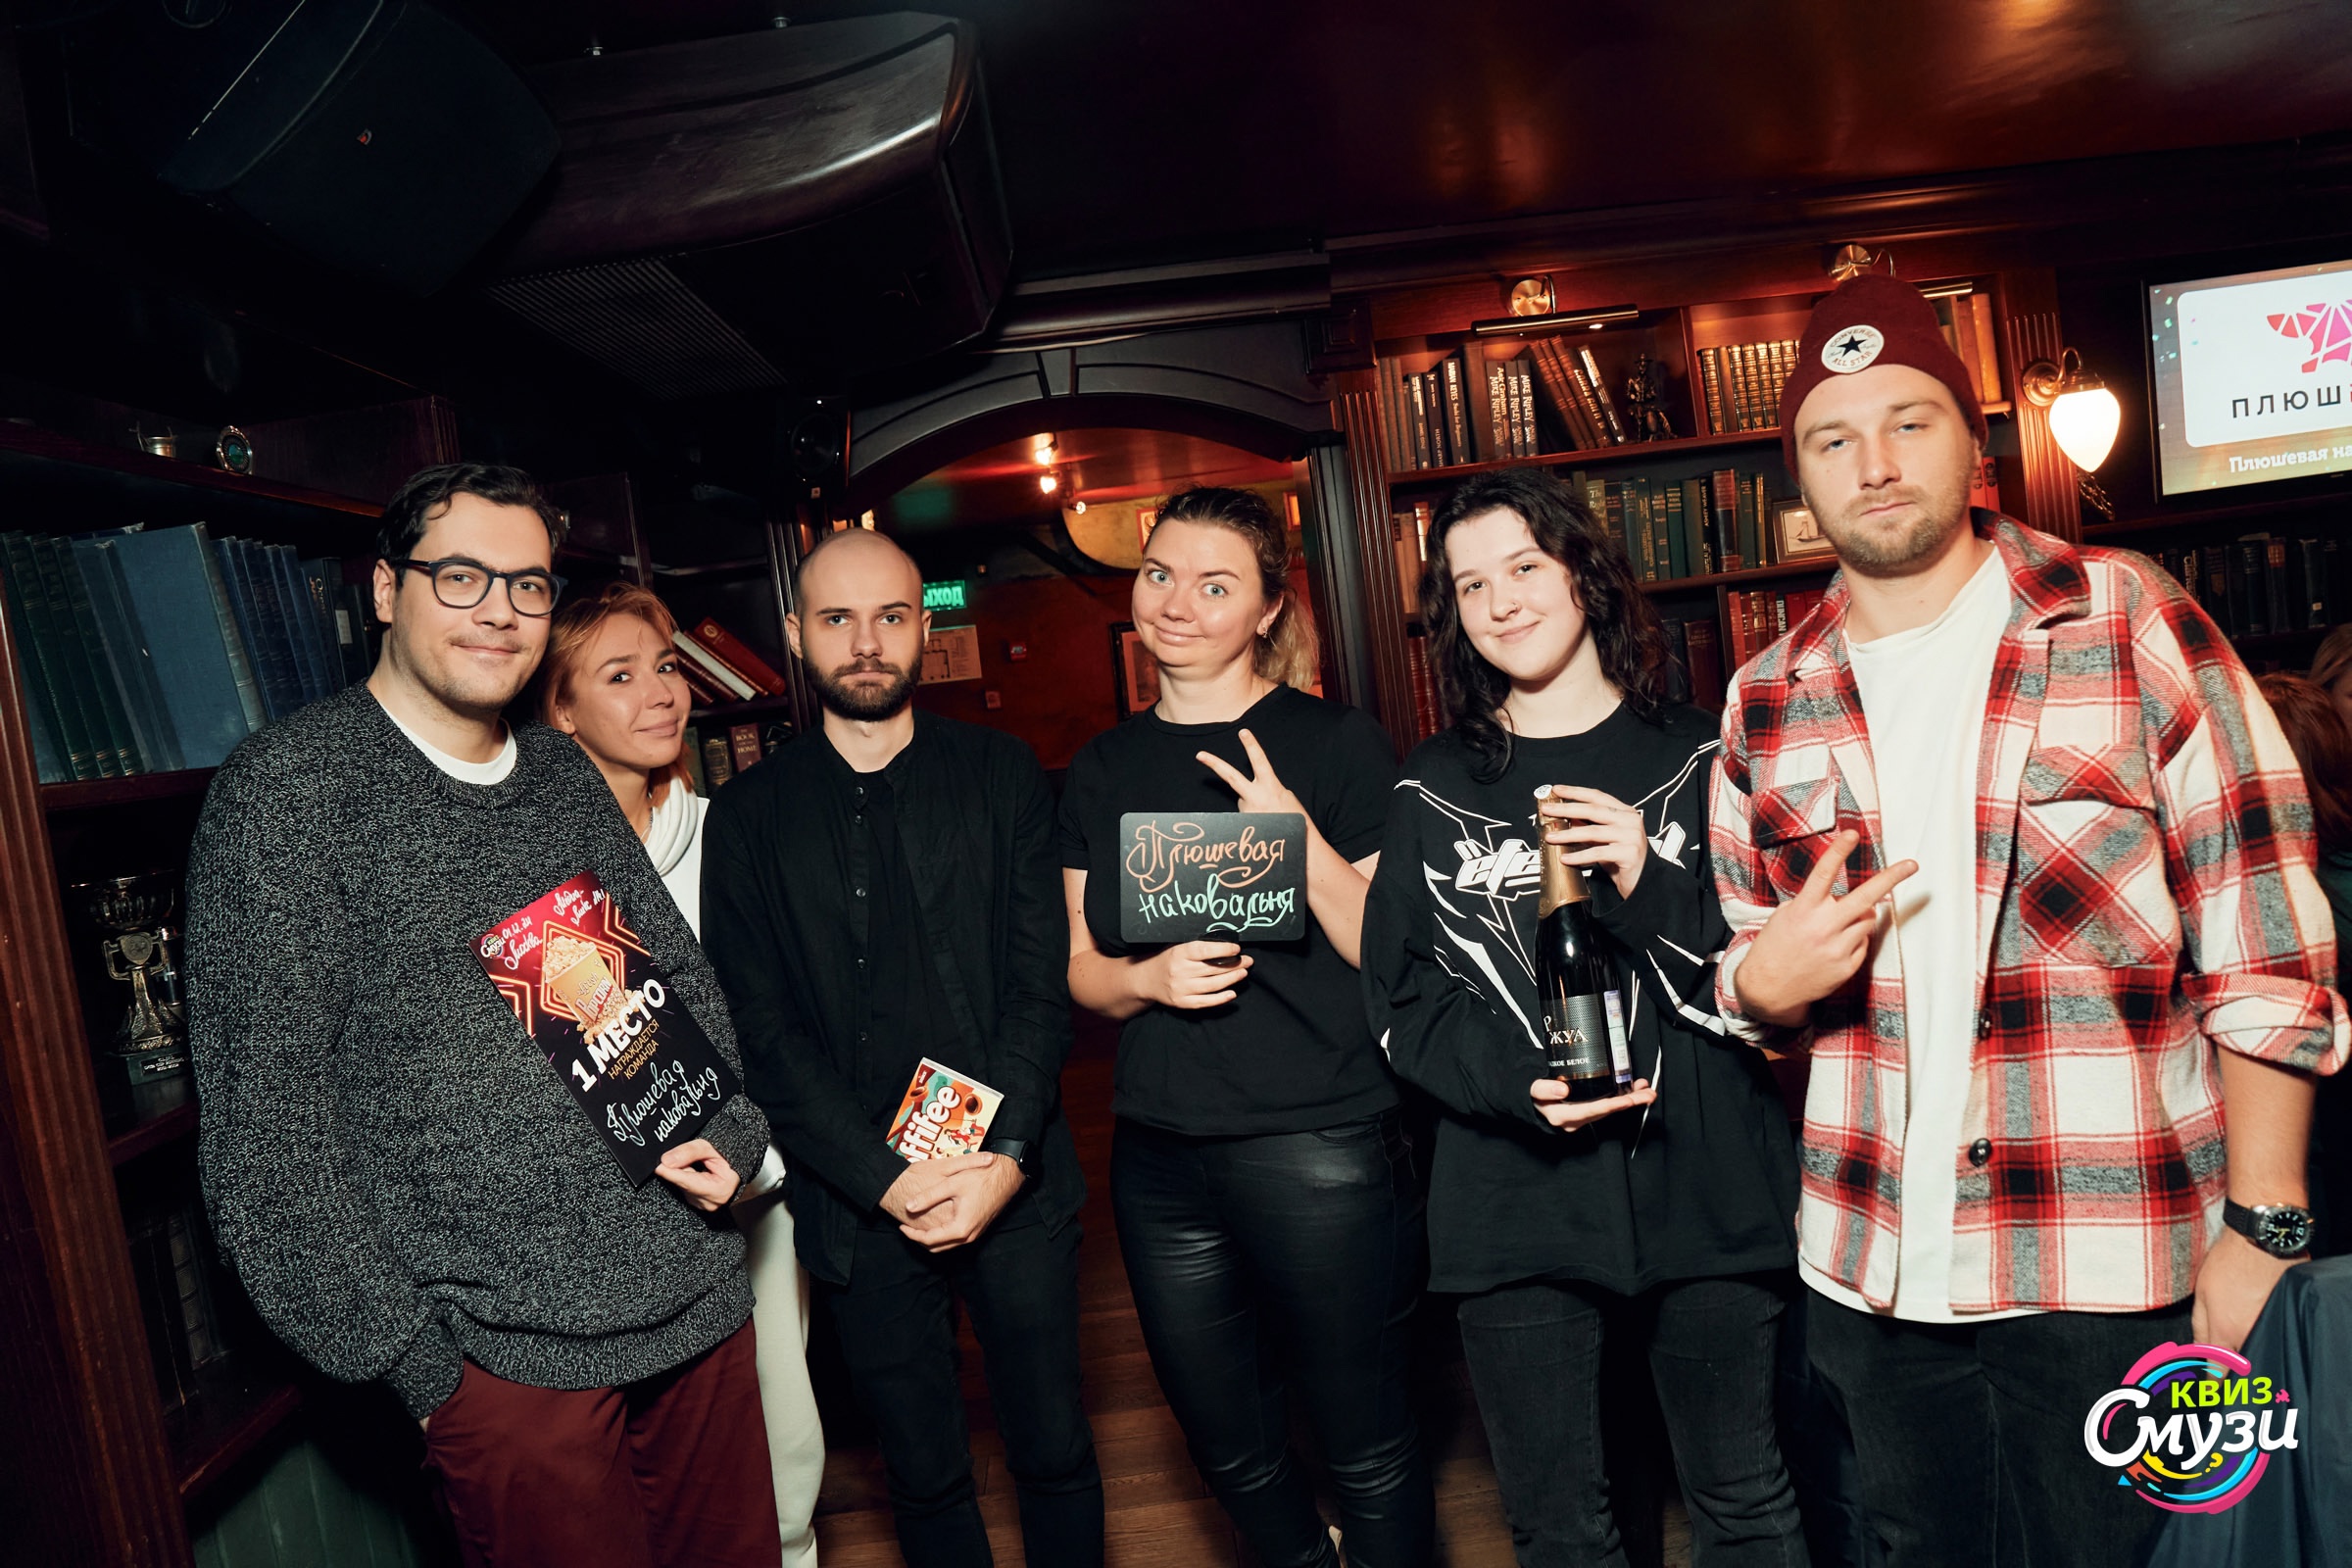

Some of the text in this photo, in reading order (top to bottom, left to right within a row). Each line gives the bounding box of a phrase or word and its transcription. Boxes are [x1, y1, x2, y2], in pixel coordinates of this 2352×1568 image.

[1831, 328, 1876, 348] CONVERSE
[1832, 351, 1873, 367] ALL STAR
[1449, 384, 1458, 401] KEYES
[1490, 376, 1502, 423] MIKE RIPLEY
[1498, 383, 1507, 416] Graham
[1508, 376, 1521, 423] MIKE RIPLEY
[1521, 375, 1535, 422] MIKE RIPLEY
[2229, 444, 2352, 473] Плюшевая на
[923, 586, 964, 607] ЫХОД
[1776, 600, 1787, 632] DUNCAN
[735, 733, 756, 742] BOOK
[737, 745, 758, 754] HOME
[1126, 819, 1286, 893] Плюшевая
[1139, 873, 1296, 933] наковальня
[480, 937, 506, 958] Смузи
[571, 978, 665, 1093] 1 МЕСТО
[608, 1019, 660, 1080] НАГРАЖДАЕТСЯ
[623, 1039, 660, 1080] КОМАНДА
[606, 1059, 689, 1147] Плюшевая
[654, 1066, 721, 1143] наковальня
[899, 1086, 961, 1163] ffifee
